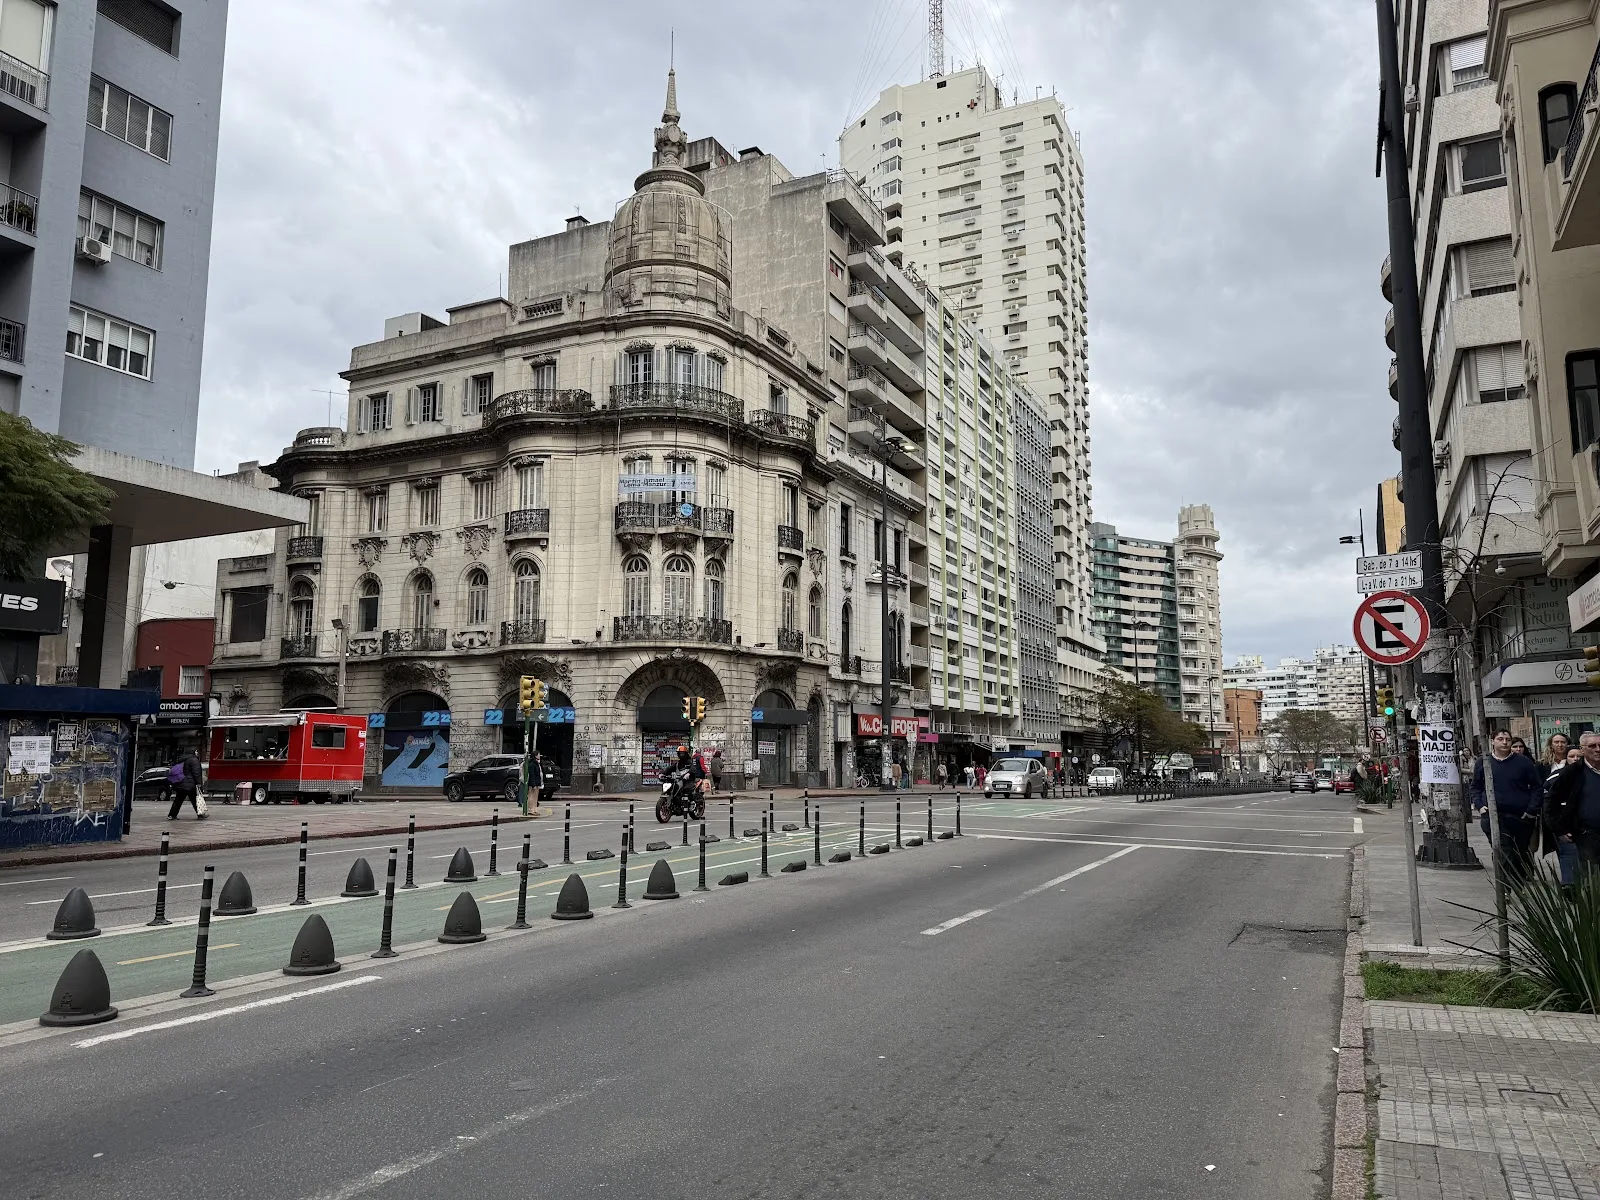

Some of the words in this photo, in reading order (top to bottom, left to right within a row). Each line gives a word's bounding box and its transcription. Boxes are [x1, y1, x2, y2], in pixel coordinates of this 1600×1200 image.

[1388, 558, 1393, 568] 7
[1394, 559, 1399, 568] a
[1388, 577, 1392, 588] 7
[1394, 578, 1398, 587] a
[0, 593, 39, 611] ES
[1372, 605, 1407, 649] E
[1559, 694, 1593, 704] exchange
[160, 702, 190, 710] ambar
[369, 713, 385, 728] 22
[423, 711, 440, 726] 22
[440, 713, 451, 723] 22
[485, 710, 503, 725] 22
[549, 708, 565, 723] 22
[565, 710, 575, 720] 22
[752, 710, 764, 720] 22
[872, 717, 918, 735] CFORT
[1421, 729, 1454, 742] NO
